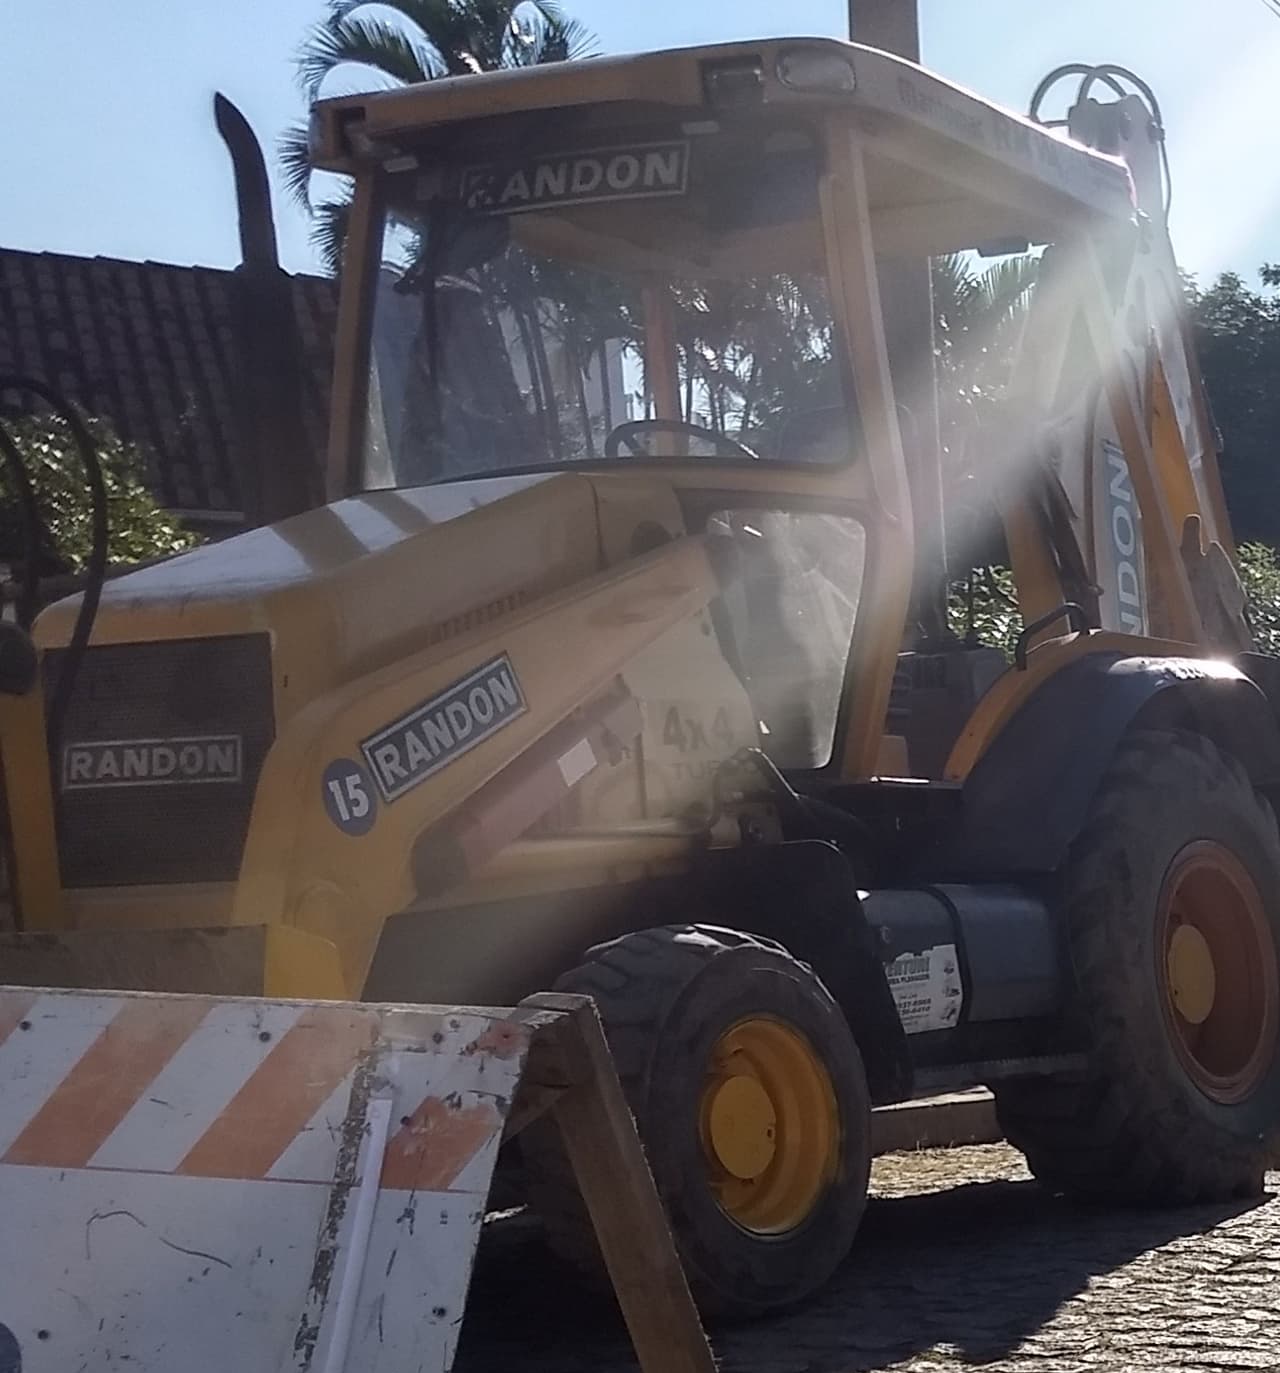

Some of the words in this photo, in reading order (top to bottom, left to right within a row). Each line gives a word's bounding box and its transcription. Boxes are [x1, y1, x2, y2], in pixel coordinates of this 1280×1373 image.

[374, 671, 518, 786] RANDON
[69, 744, 234, 780] RANDON
[328, 774, 369, 821] 15
